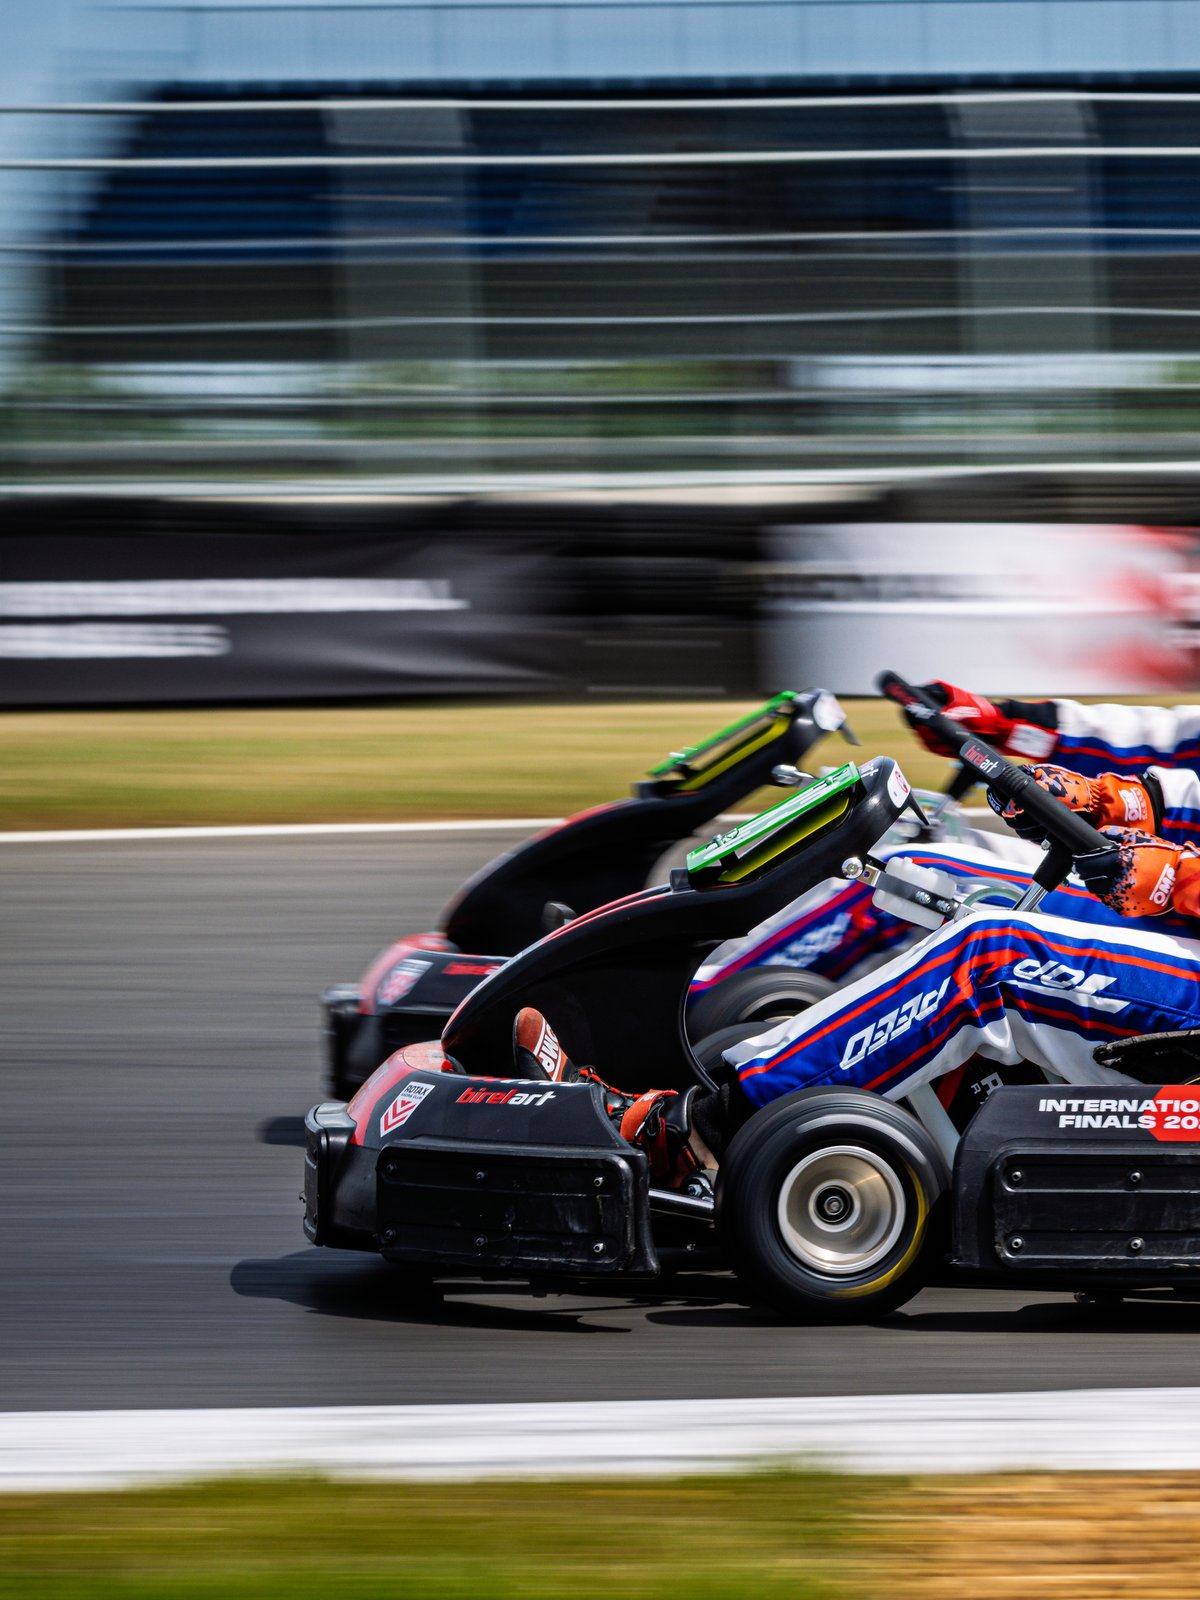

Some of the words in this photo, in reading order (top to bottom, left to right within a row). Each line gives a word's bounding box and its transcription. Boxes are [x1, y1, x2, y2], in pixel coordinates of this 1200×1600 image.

[963, 744, 999, 774] birelart
[1153, 866, 1176, 905] OMP
[404, 1084, 430, 1096] ROTAX
[455, 1087, 557, 1106] birelart
[1058, 1114, 1157, 1129] FINALS
